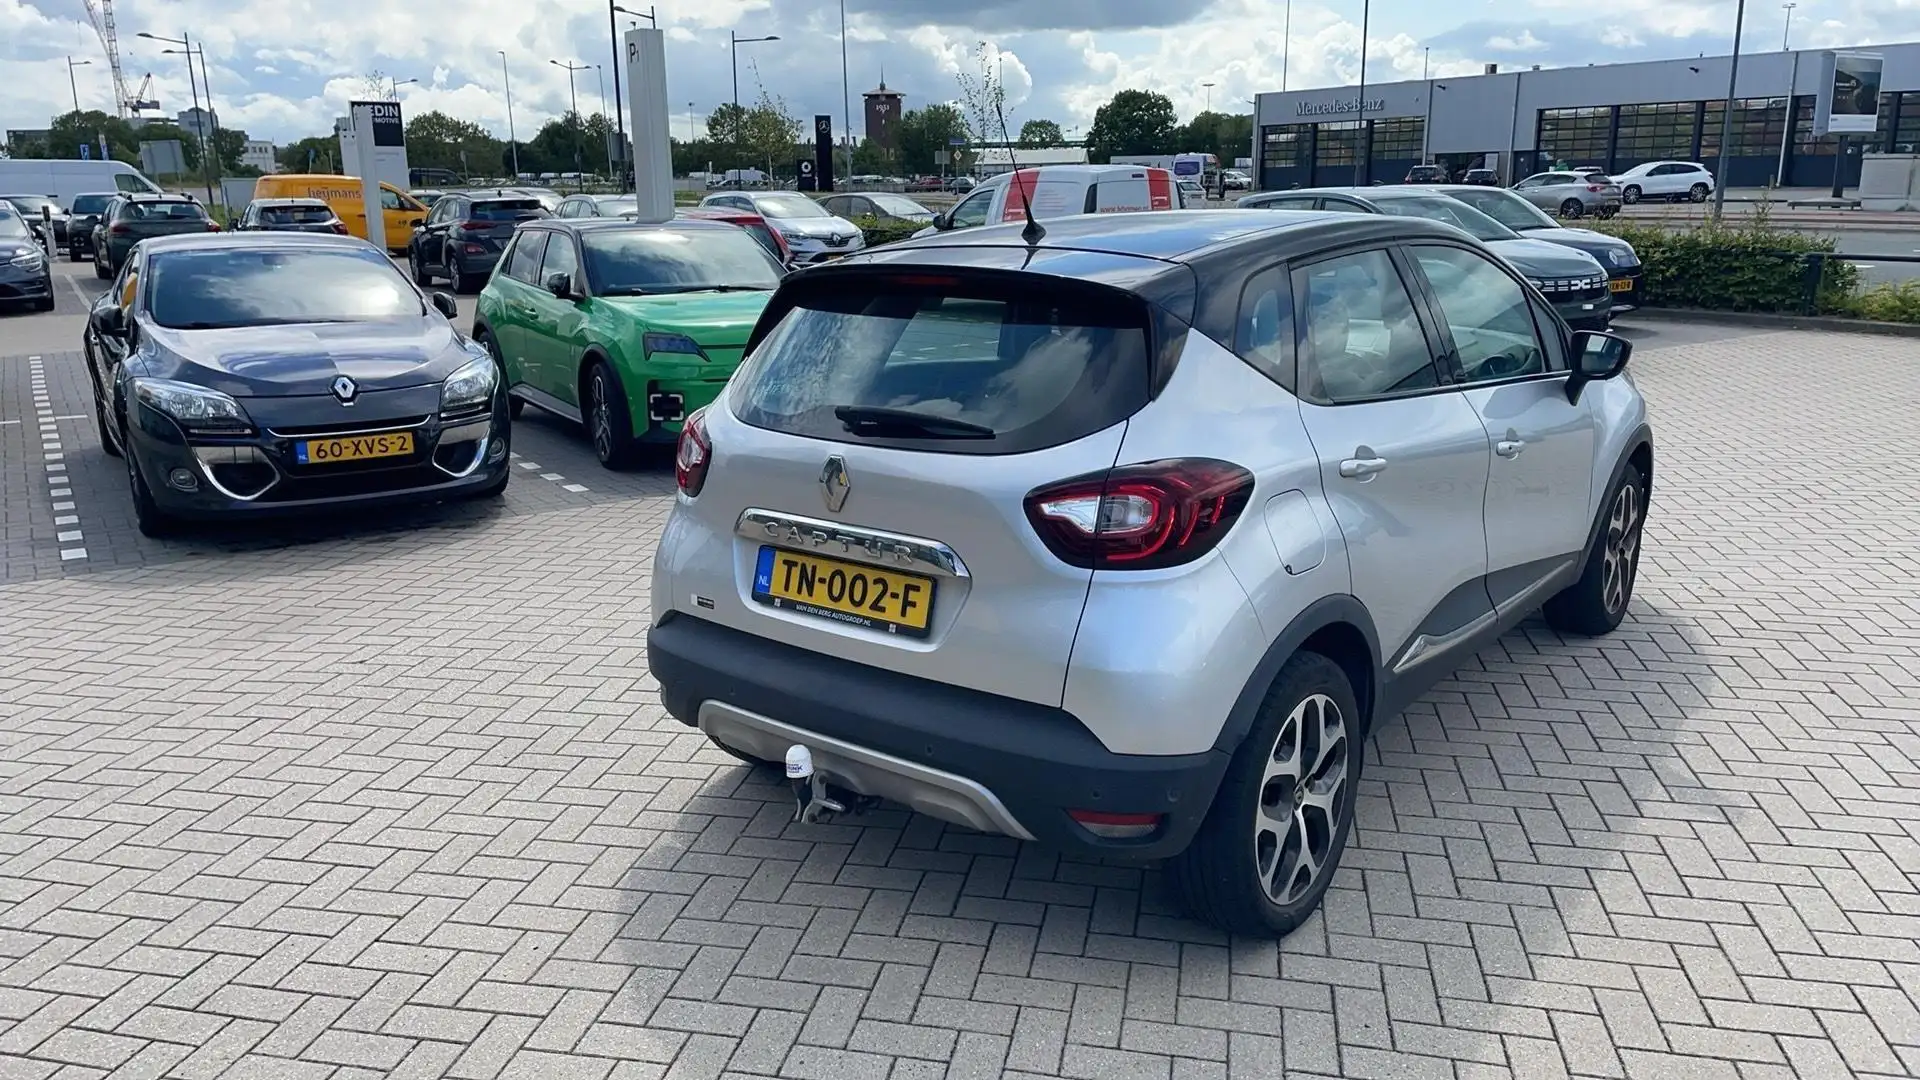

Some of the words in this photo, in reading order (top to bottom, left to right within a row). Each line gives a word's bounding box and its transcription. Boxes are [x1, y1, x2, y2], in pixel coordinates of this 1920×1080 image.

[1296, 97, 1384, 116] Mercedes-Benz
[316, 435, 408, 459] 60-XVS-2
[764, 521, 913, 564] CAPTUR
[758, 575, 769, 587] NL
[782, 559, 921, 618] TN-002-F
[807, 606, 818, 614] DEN
[818, 609, 832, 617] BERG
[831, 612, 872, 627] AUTOGROEP.NL
